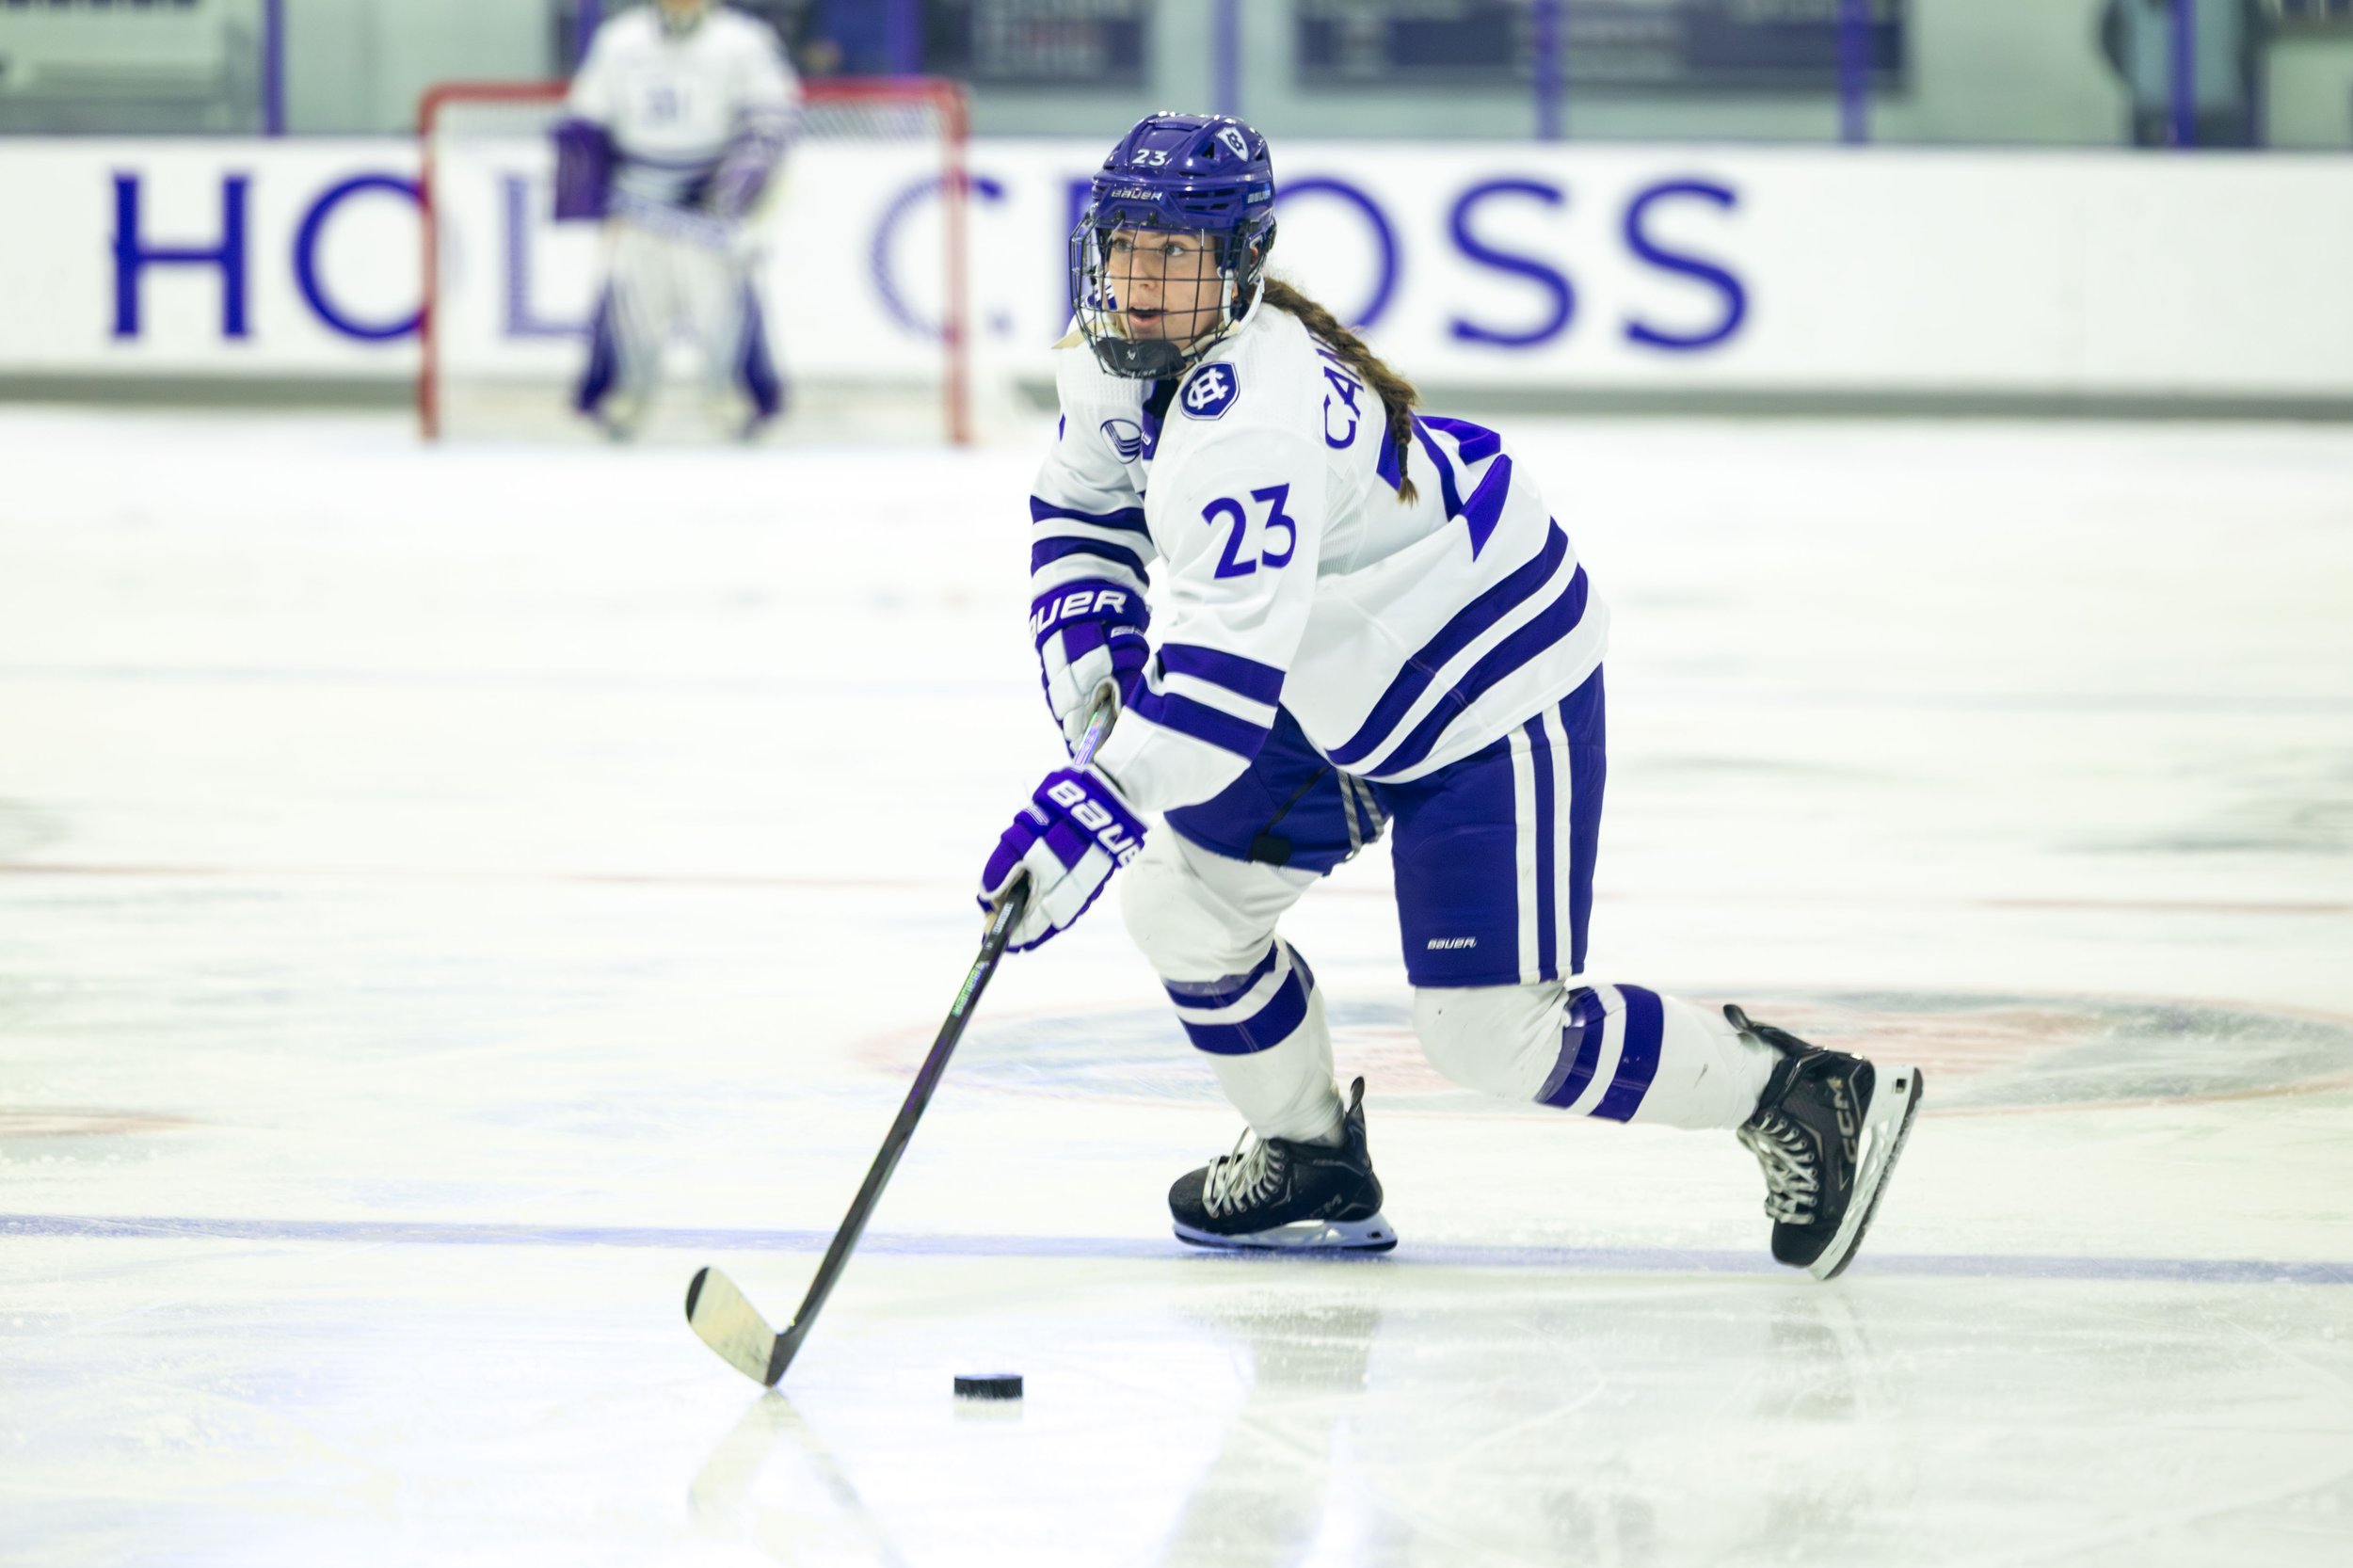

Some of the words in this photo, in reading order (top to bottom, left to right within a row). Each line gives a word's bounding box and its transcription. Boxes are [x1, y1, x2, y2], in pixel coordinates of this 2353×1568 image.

[1131, 148, 1168, 167] 23
[1111, 188, 1163, 201] BAUER
[110, 173, 595, 342] HOL
[871, 177, 1751, 350] COSS
[1202, 483, 1296, 579] 23
[1029, 589, 1128, 638] UER
[1047, 779, 1140, 868] BAUE
[1426, 936, 1478, 950] BAUER
[1827, 1076, 1858, 1164] CCM
